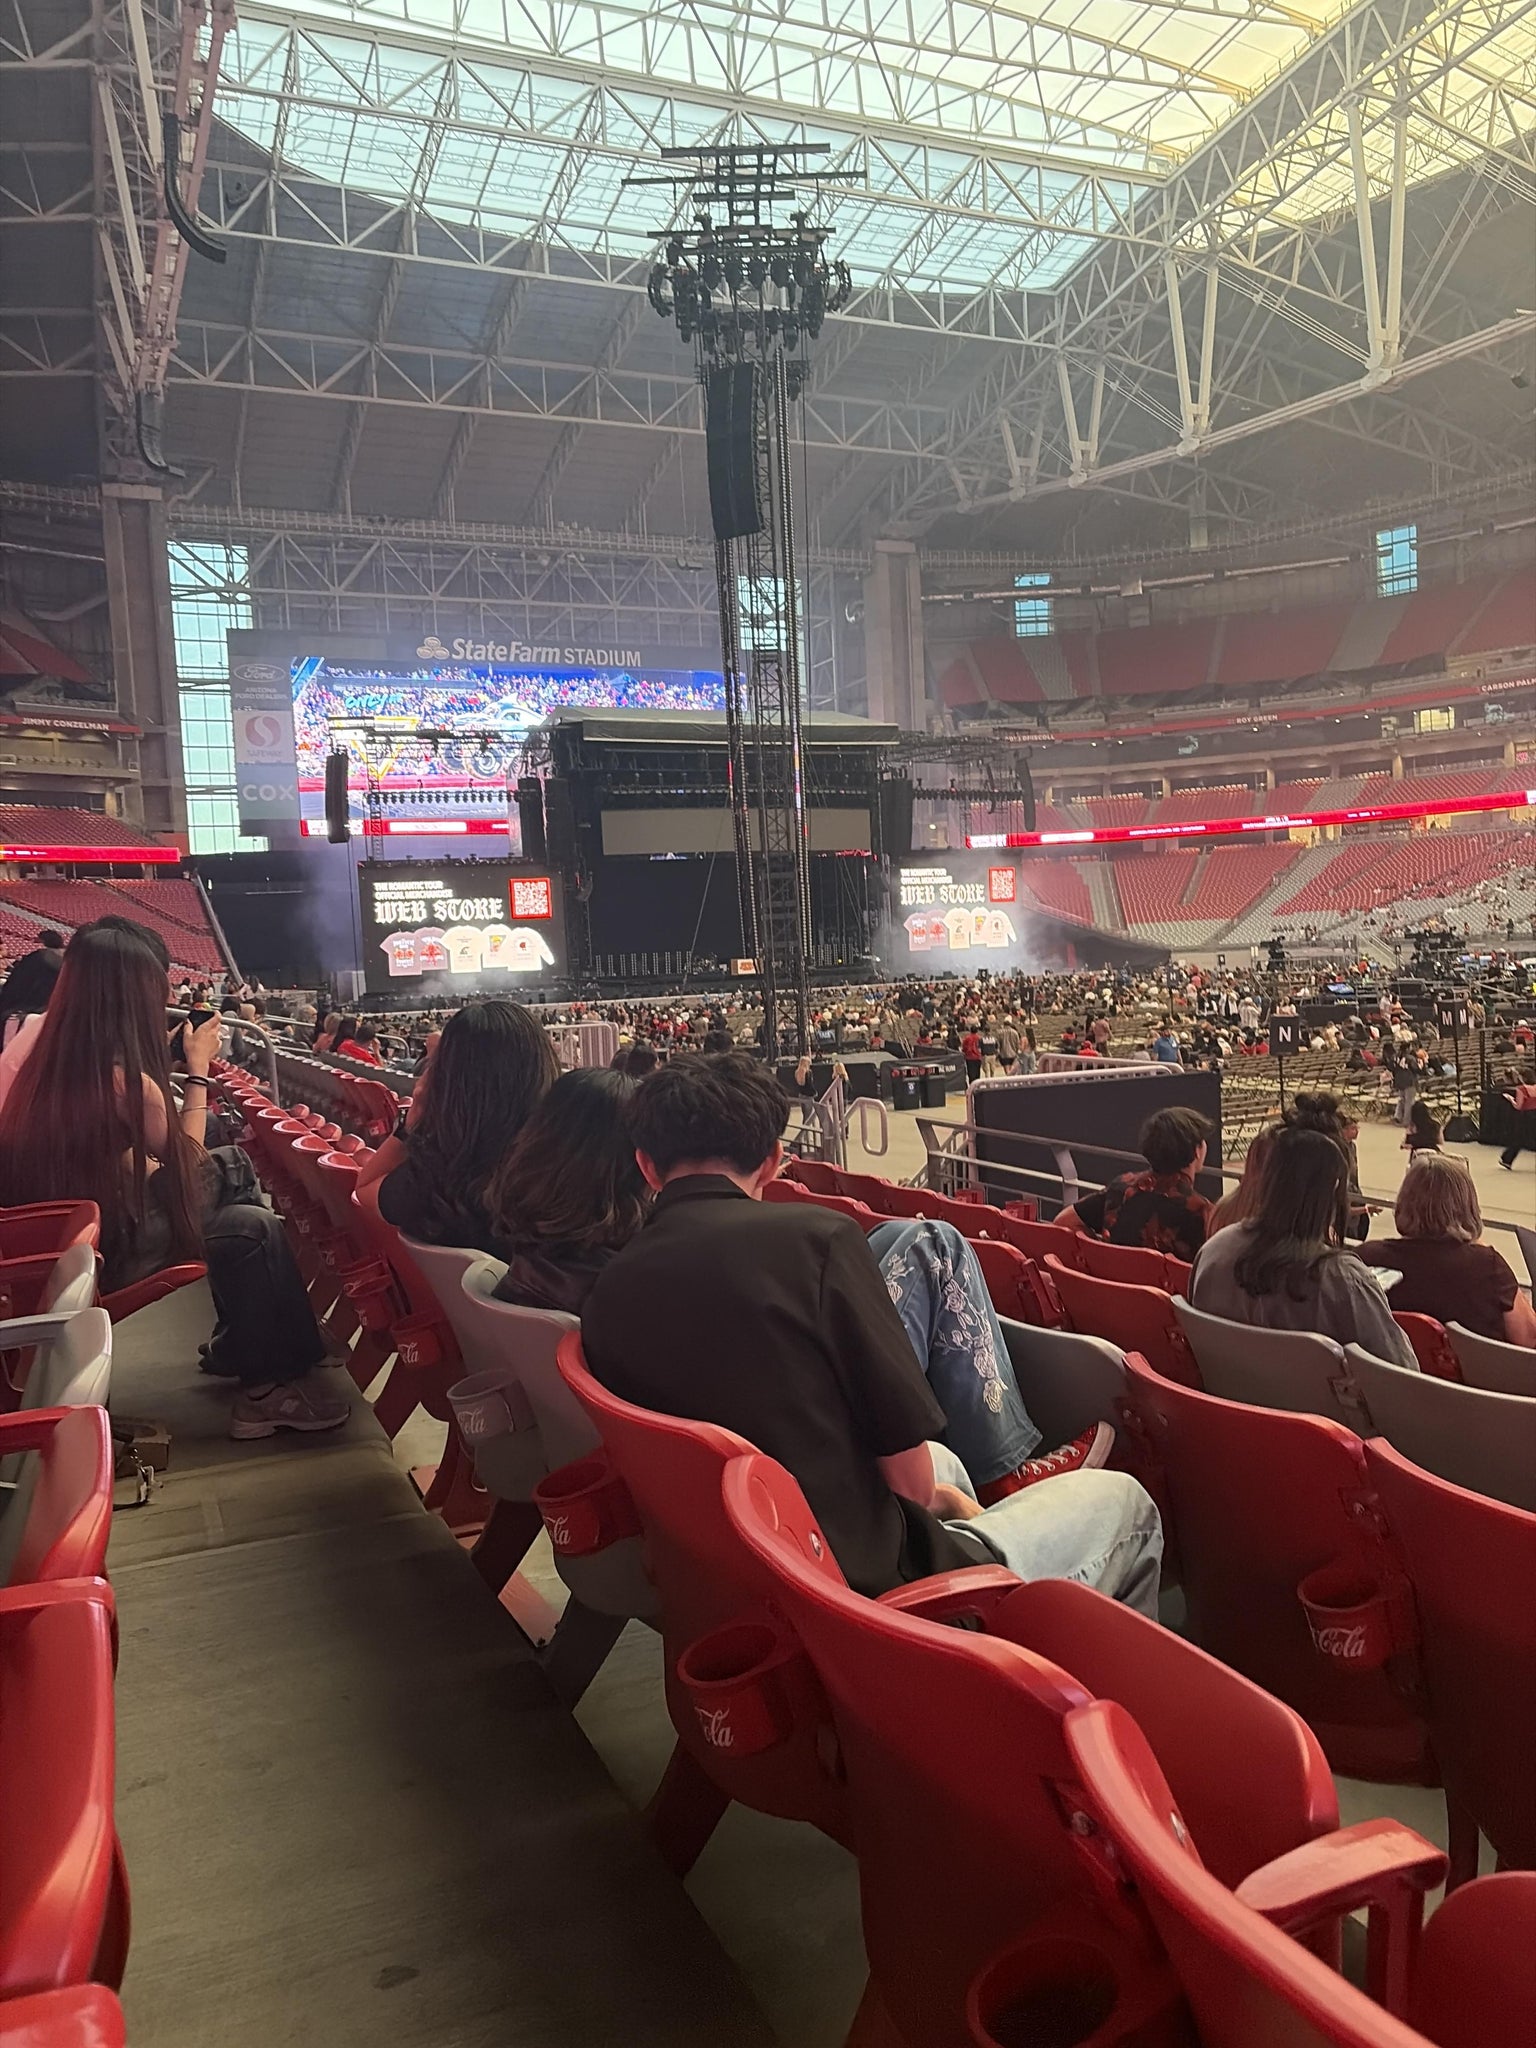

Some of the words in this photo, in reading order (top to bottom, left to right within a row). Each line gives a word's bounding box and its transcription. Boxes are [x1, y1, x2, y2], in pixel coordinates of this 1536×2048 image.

[564, 648, 641, 667] STADIUM
[1481, 682, 1515, 692] CARSON
[22, 717, 51, 727] JIMMY
[53, 719, 109, 731] CONZELMAN
[1253, 714, 1278, 722] GREEN
[242, 784, 295, 801] COX
[900, 884, 935, 905] WEB
[939, 883, 985, 904] STORE
[374, 900, 428, 923] WEB
[432, 898, 504, 922] STORE
[1442, 1010, 1453, 1026] M
[1278, 1026, 1291, 1043] N
